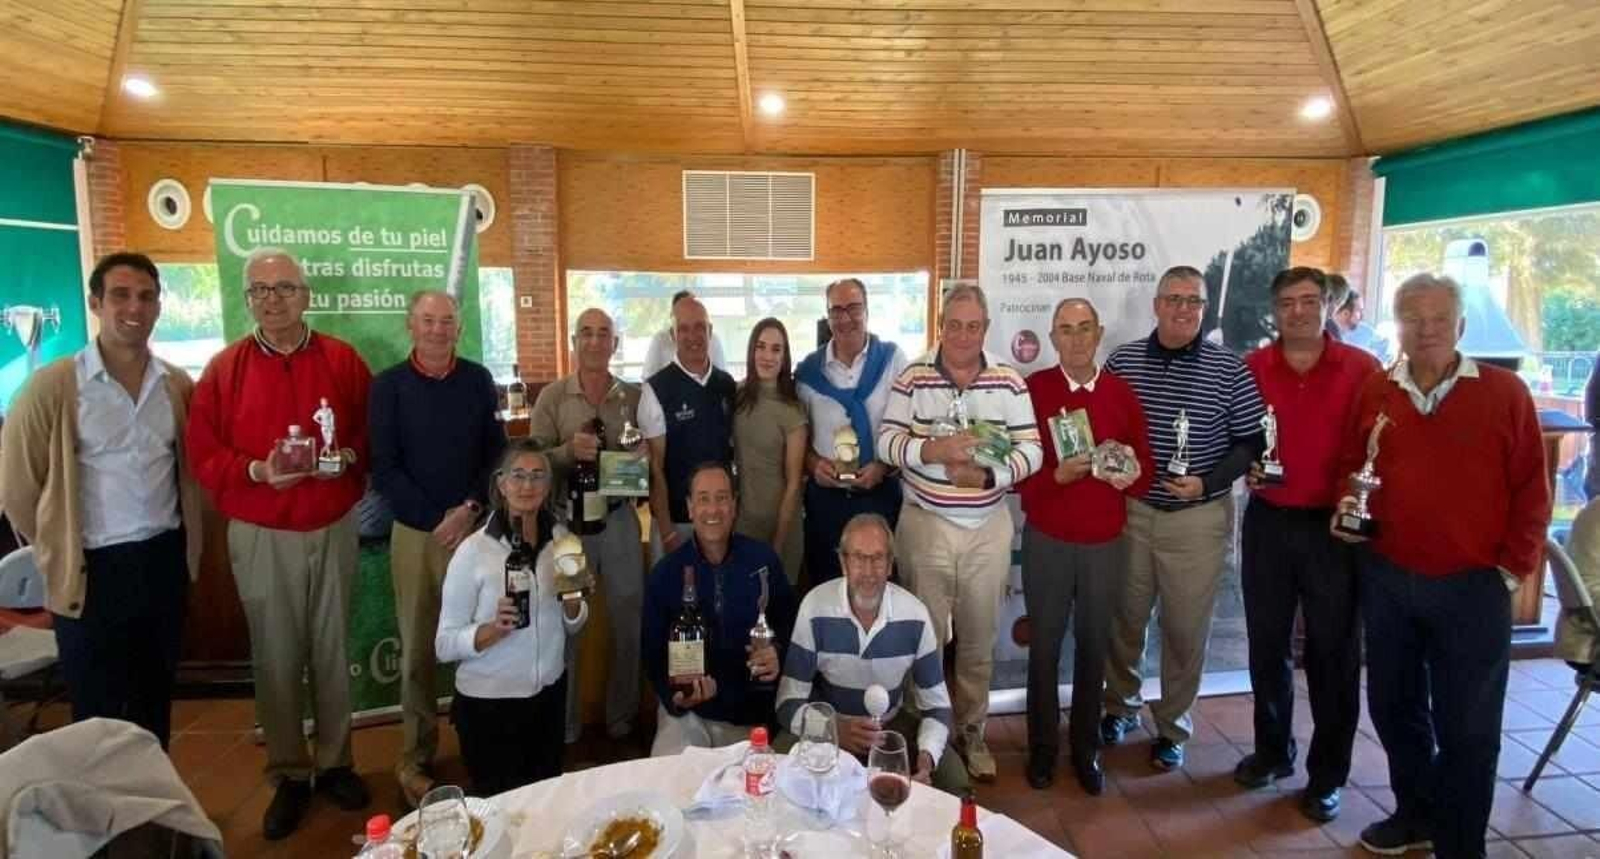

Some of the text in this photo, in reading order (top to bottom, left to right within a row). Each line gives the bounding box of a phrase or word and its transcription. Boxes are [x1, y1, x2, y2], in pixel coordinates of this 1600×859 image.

[1008, 211, 1083, 224] Memorial
[224, 203, 447, 257] Cuidamos de tu piel
[1004, 237, 1146, 266] Juan Ayoso
[351, 257, 445, 277] disfrutas
[1001, 272, 1027, 284] 1945
[1061, 271, 1086, 284] Base
[1088, 271, 1116, 283] Naval
[1118, 271, 1130, 282] de
[308, 288, 405, 312] tu pasión
